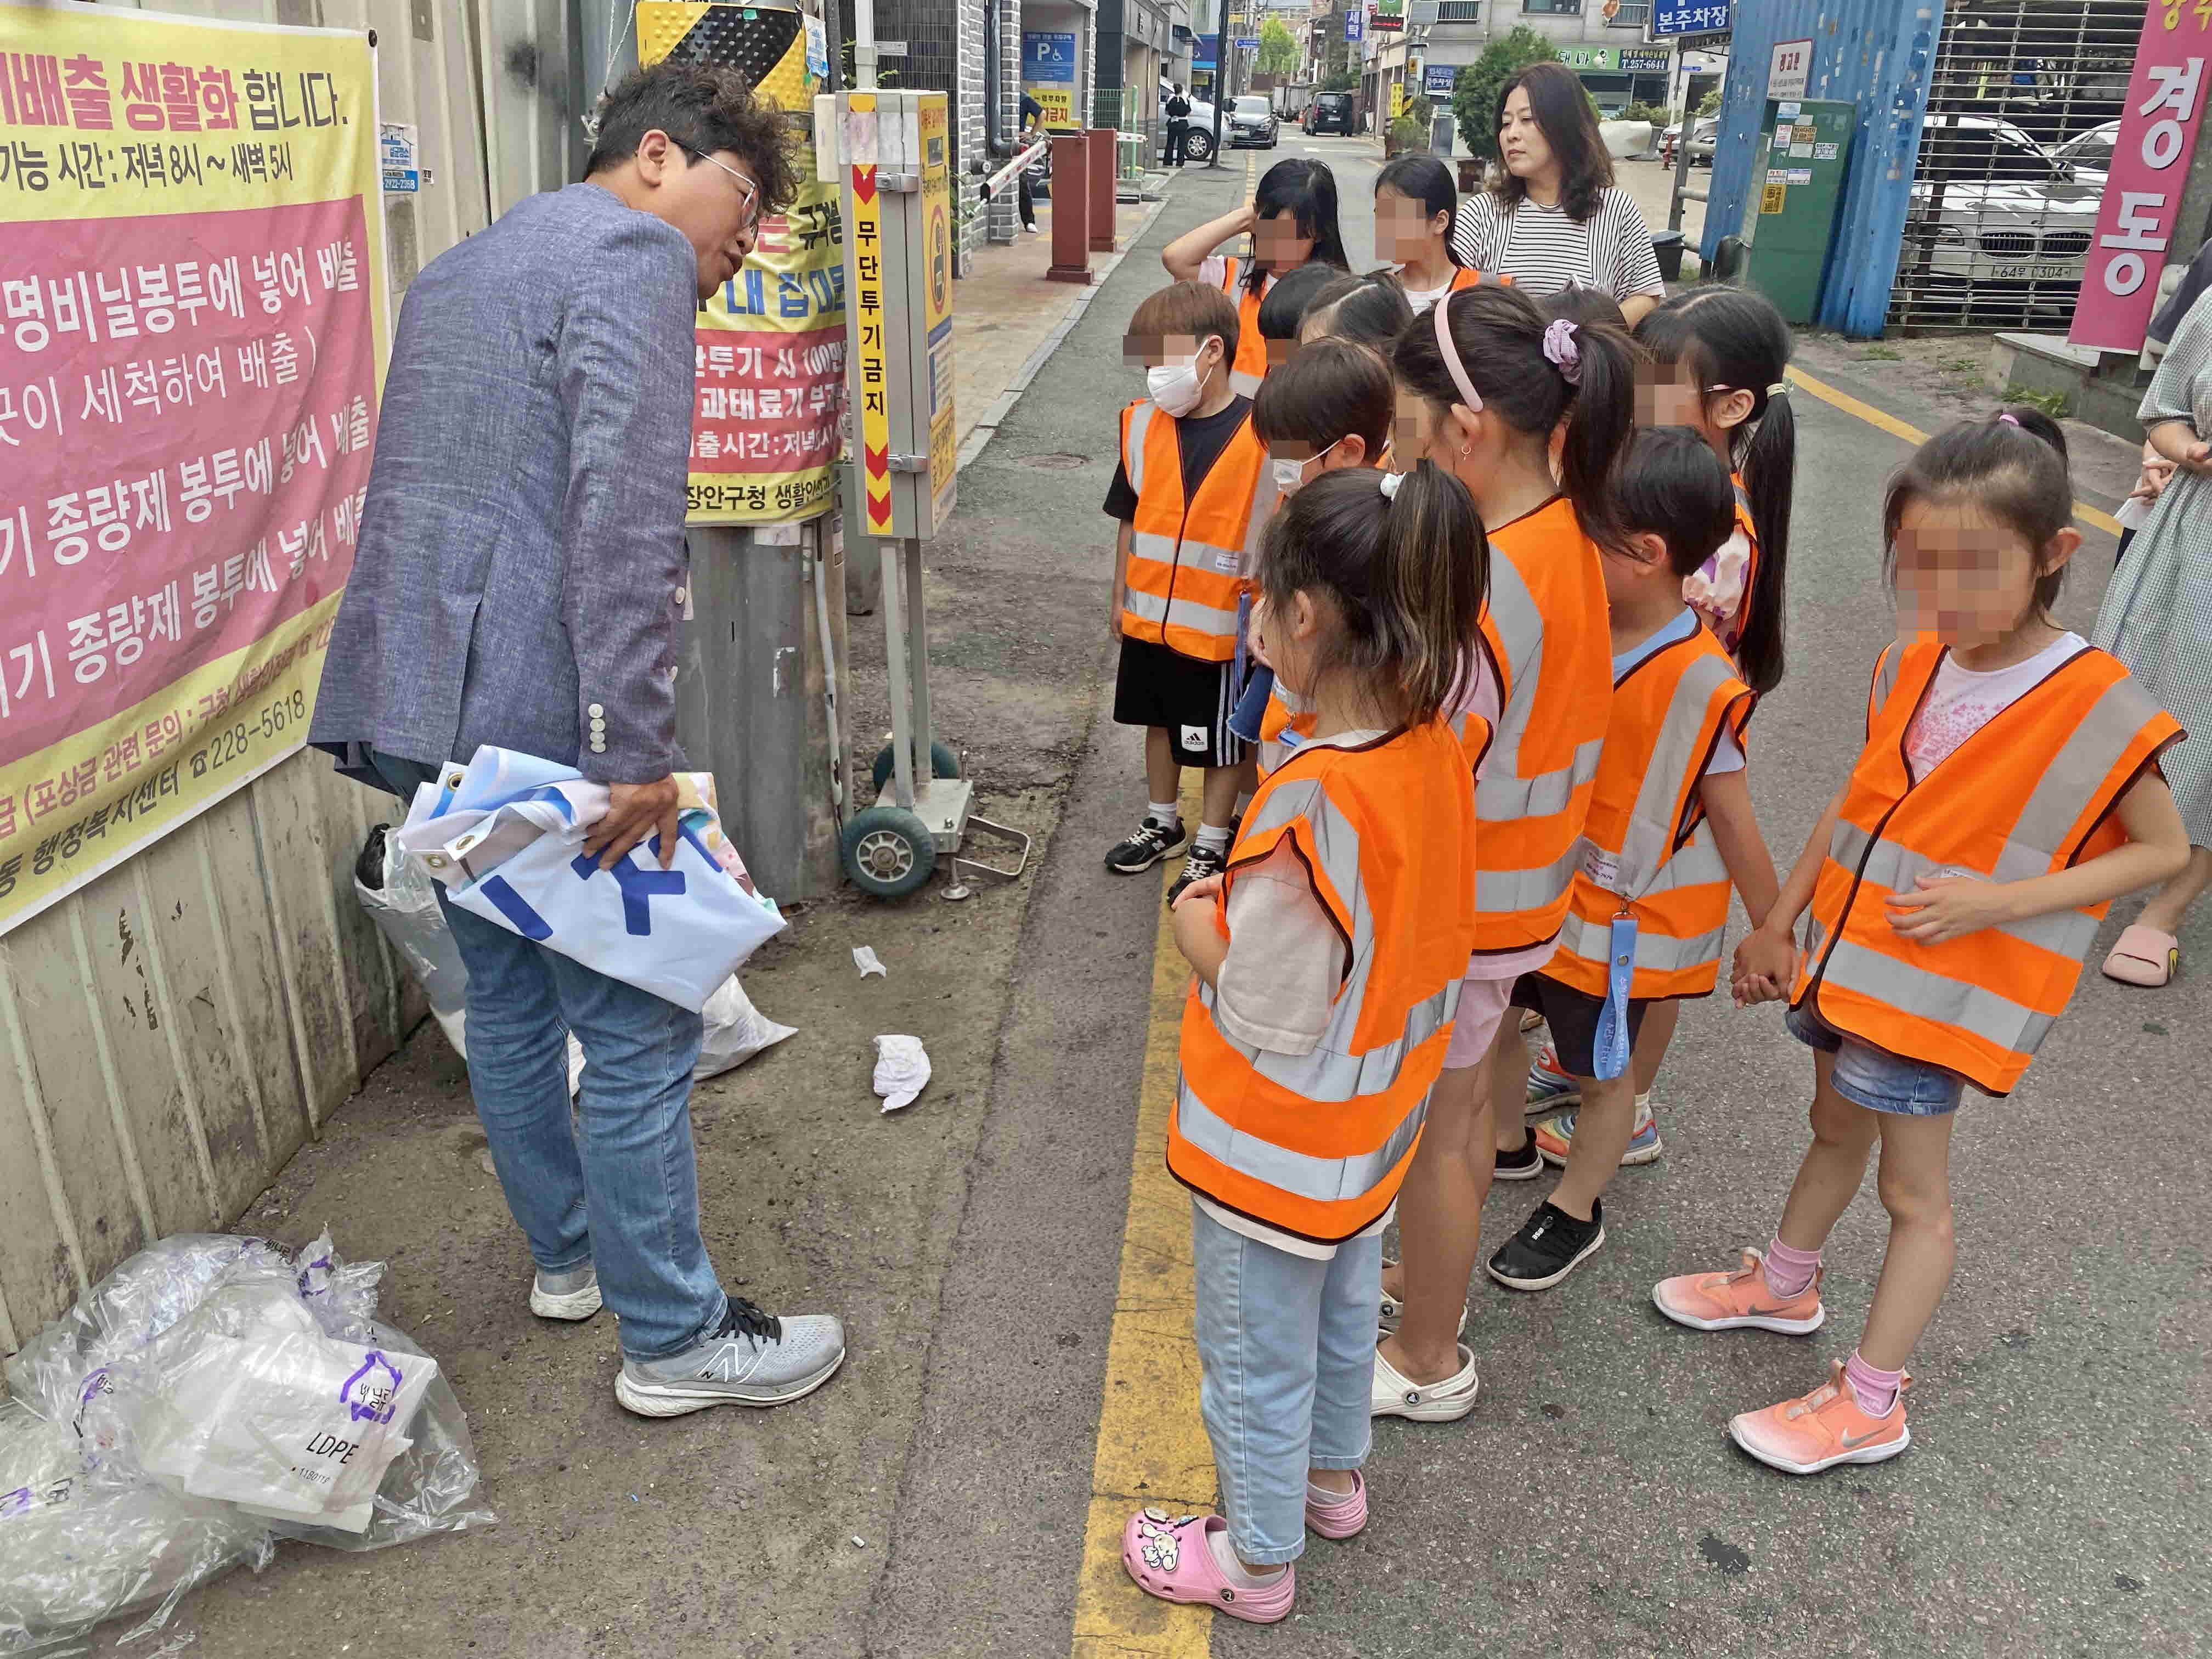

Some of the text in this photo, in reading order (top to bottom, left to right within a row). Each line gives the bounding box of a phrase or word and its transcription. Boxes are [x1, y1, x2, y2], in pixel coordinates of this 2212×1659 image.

[1347, 12, 1359, 37] 세탁
[1657, 5, 1729, 33] 본주차장
[1037, 43, 1051, 61] P
[1622, 58, 1665, 69] T.257-6644
[120, 61, 240, 132] 생활화
[244, 69, 349, 131] 합니다.
[121, 142, 167, 189] 저녁
[170, 142, 204, 187] 8시
[232, 143, 268, 185] 새벽
[270, 142, 294, 181] 5시
[0, 256, 245, 352] 명비닐봉투에
[252, 246, 312, 315] 넣어
[857, 221, 885, 416] 무단투기금지
[81, 346, 227, 425] 세척하여
[773, 347, 796, 379] 시
[46, 469, 171, 566] 종량제
[180, 438, 273, 523] 봉투에
[280, 414, 328, 484] 넣어
[331, 394, 369, 455] 배출
[687, 484, 765, 511] 장안구청
[67, 579, 181, 684] 종량제
[192, 536, 278, 630] 봉투에
[278, 509, 329, 580] 넣어
[104, 731, 141, 782] 관련
[33, 759, 179, 876] 행정복지센터
[211, 689, 306, 771] 228-5618
[306, 1432, 360, 1464] LDPE
